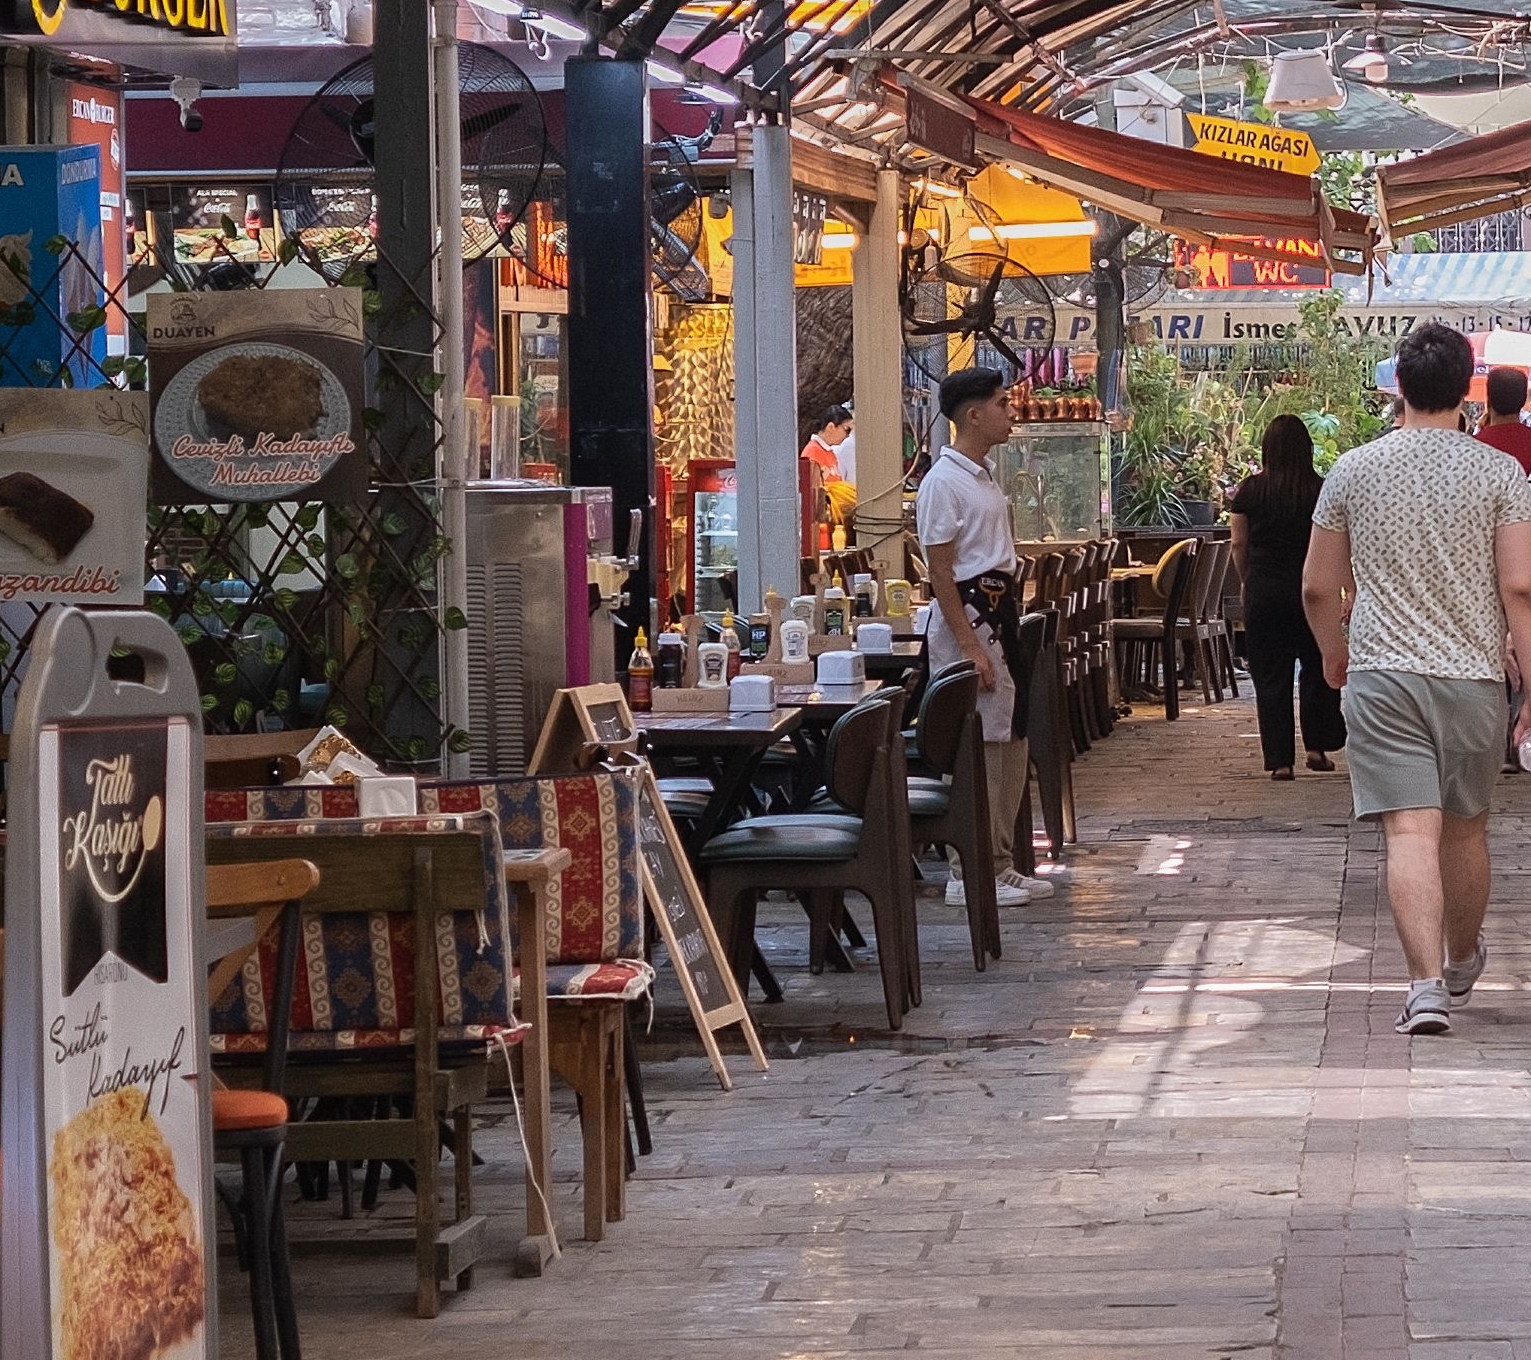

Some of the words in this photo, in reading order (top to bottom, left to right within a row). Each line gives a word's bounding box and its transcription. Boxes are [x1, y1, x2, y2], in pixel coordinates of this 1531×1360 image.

[1200, 122, 1257, 149] KIZLAR
[1259, 131, 1309, 158] AĞASI
[153, 325, 215, 339] DUAYEN
[1069, 314, 1204, 341] PARI
[1334, 315, 1418, 338] AVUZ
[172, 433, 244, 459] Cevizli
[210, 459, 321, 486] Muhallebi
[49, 1001, 109, 1065] Sütlü
